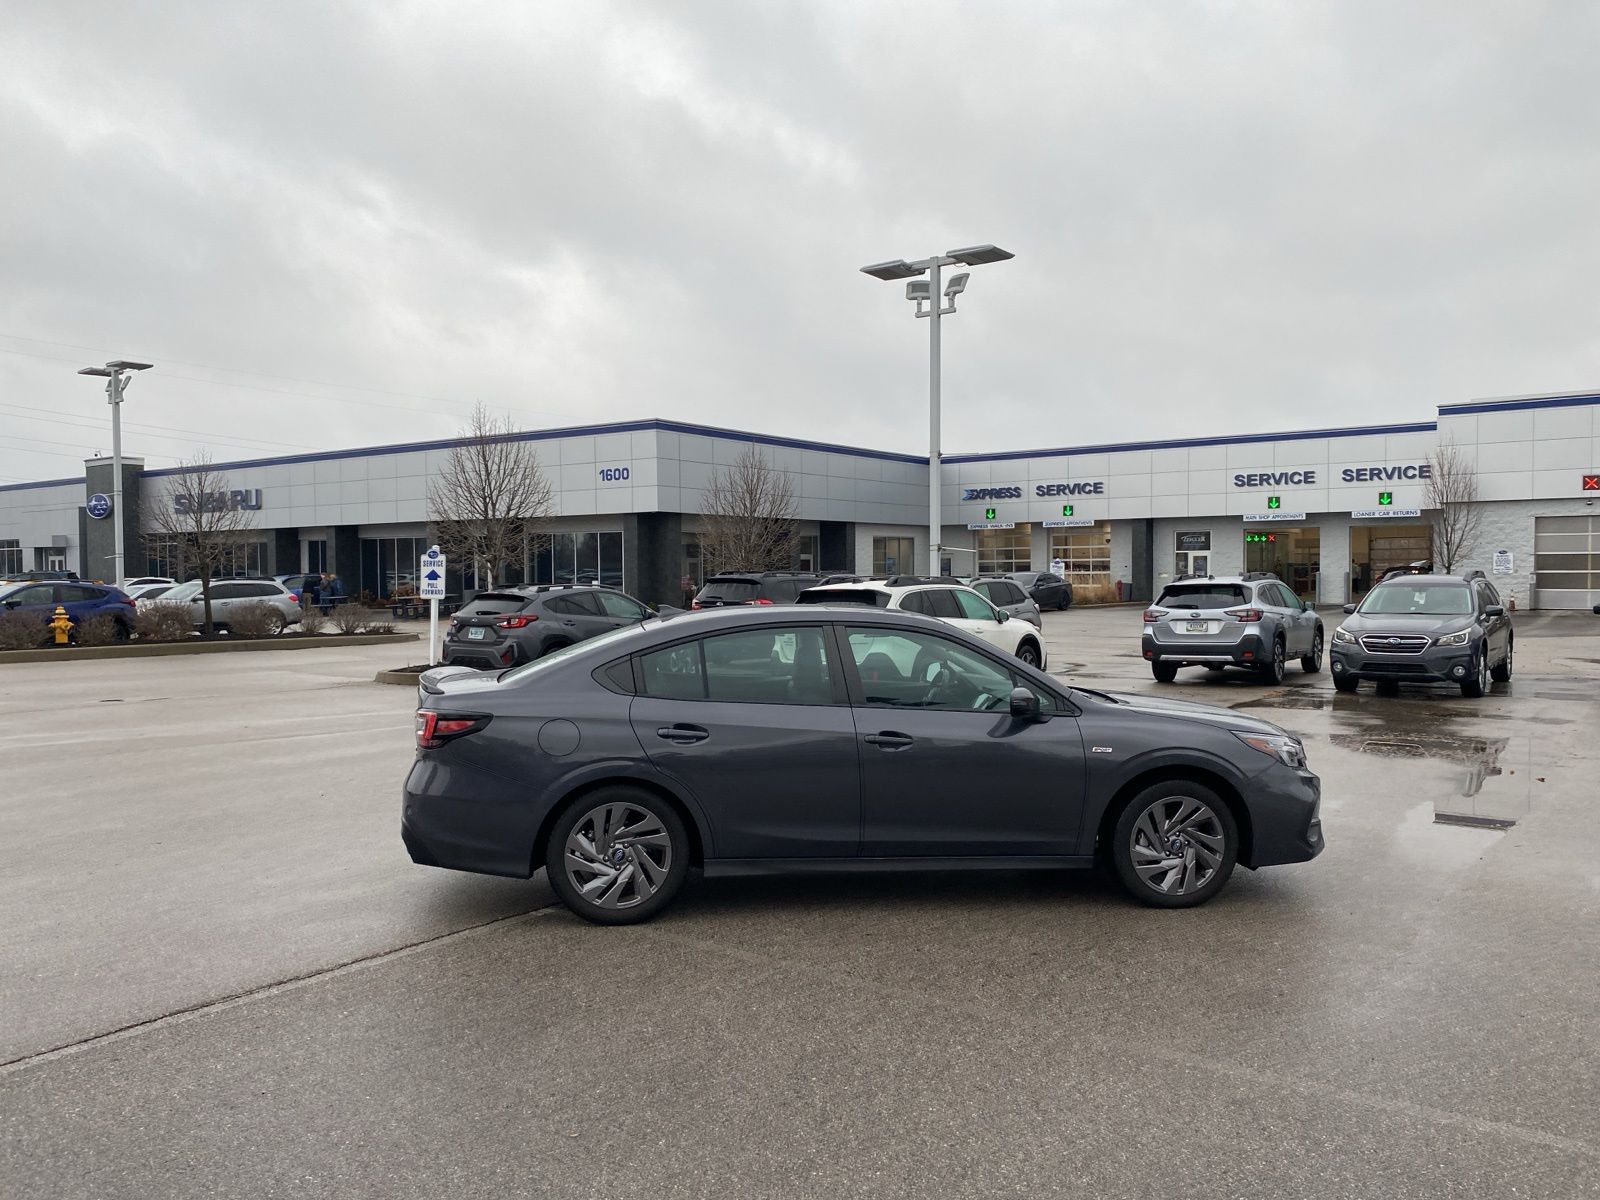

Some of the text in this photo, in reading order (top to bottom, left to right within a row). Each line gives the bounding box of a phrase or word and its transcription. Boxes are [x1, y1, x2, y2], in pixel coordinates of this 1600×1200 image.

[599, 467, 630, 481] 1600
[1234, 471, 1316, 487] SERVICE
[1342, 464, 1431, 482] SERVICE
[962, 482, 1104, 501] EXPRESS SERVICE
